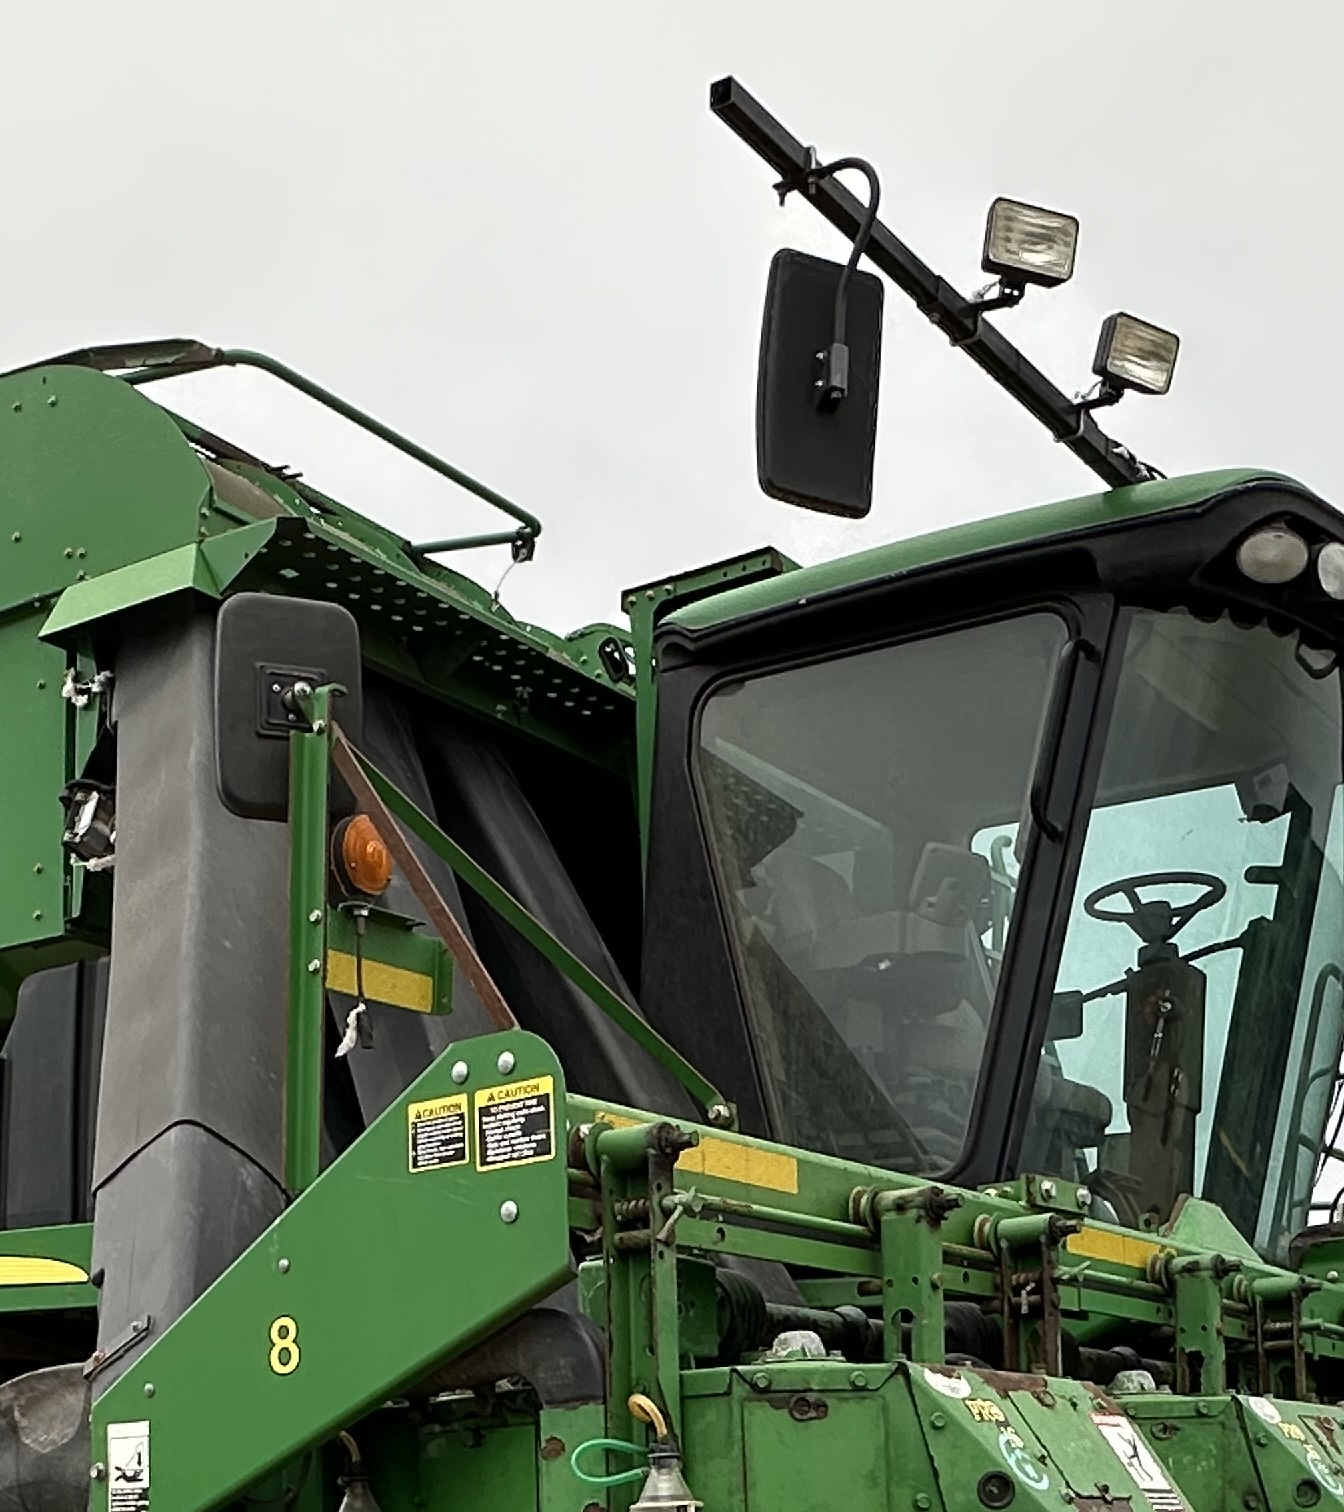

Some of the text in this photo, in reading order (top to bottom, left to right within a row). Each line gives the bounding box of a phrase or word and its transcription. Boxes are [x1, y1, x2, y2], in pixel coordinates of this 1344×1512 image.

[497, 1083, 540, 1100] CAUTION
[422, 1102, 462, 1118] CAUTION
[269, 1315, 301, 1376] 8
